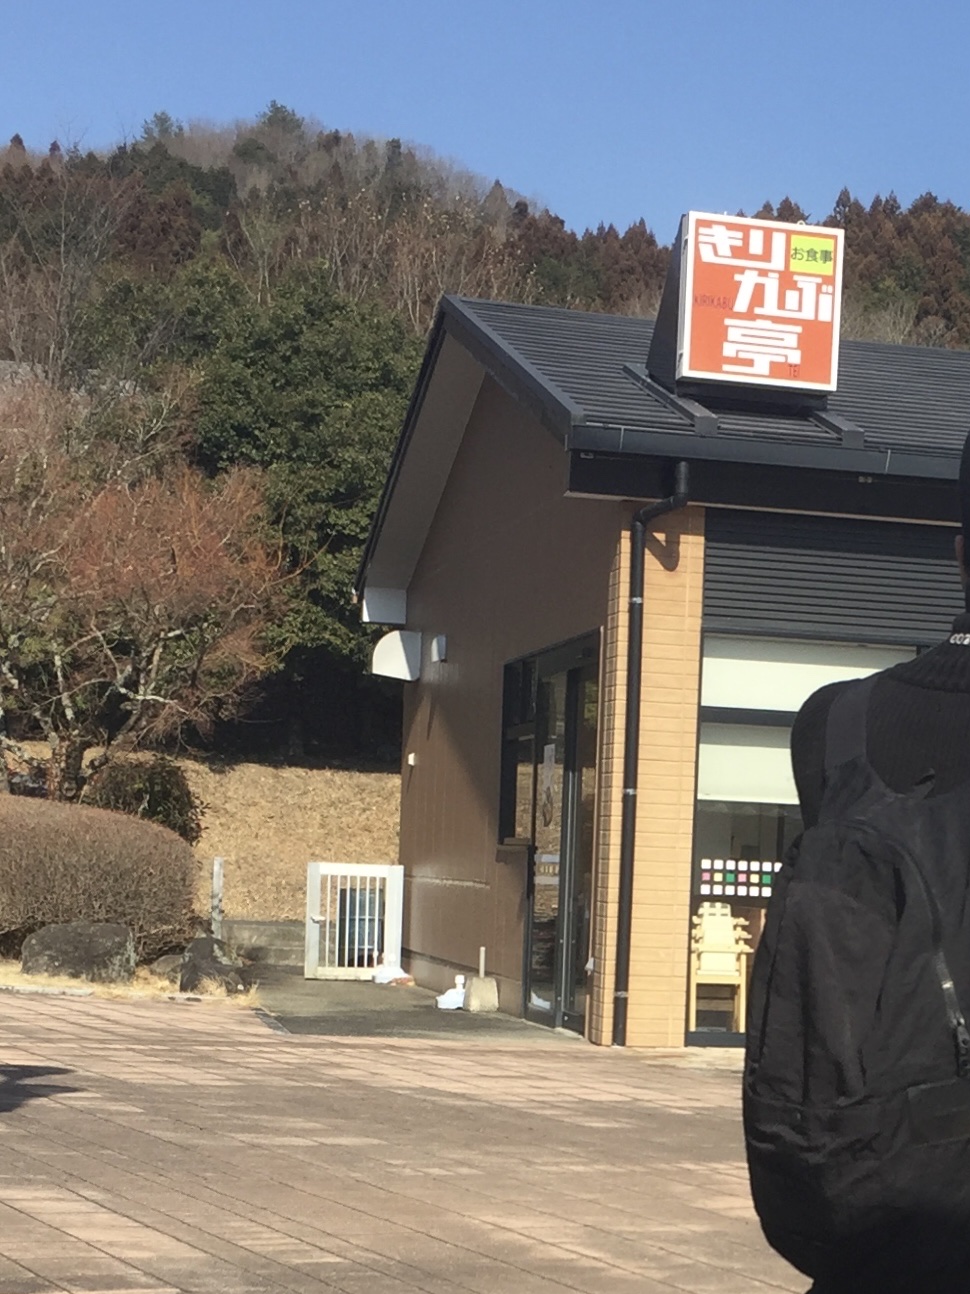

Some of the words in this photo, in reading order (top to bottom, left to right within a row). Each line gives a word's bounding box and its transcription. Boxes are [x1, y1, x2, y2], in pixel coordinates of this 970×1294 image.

[790, 247, 834, 264] お食事
[694, 295, 733, 310] KIRIKABU
[722, 318, 803, 376] 亭
